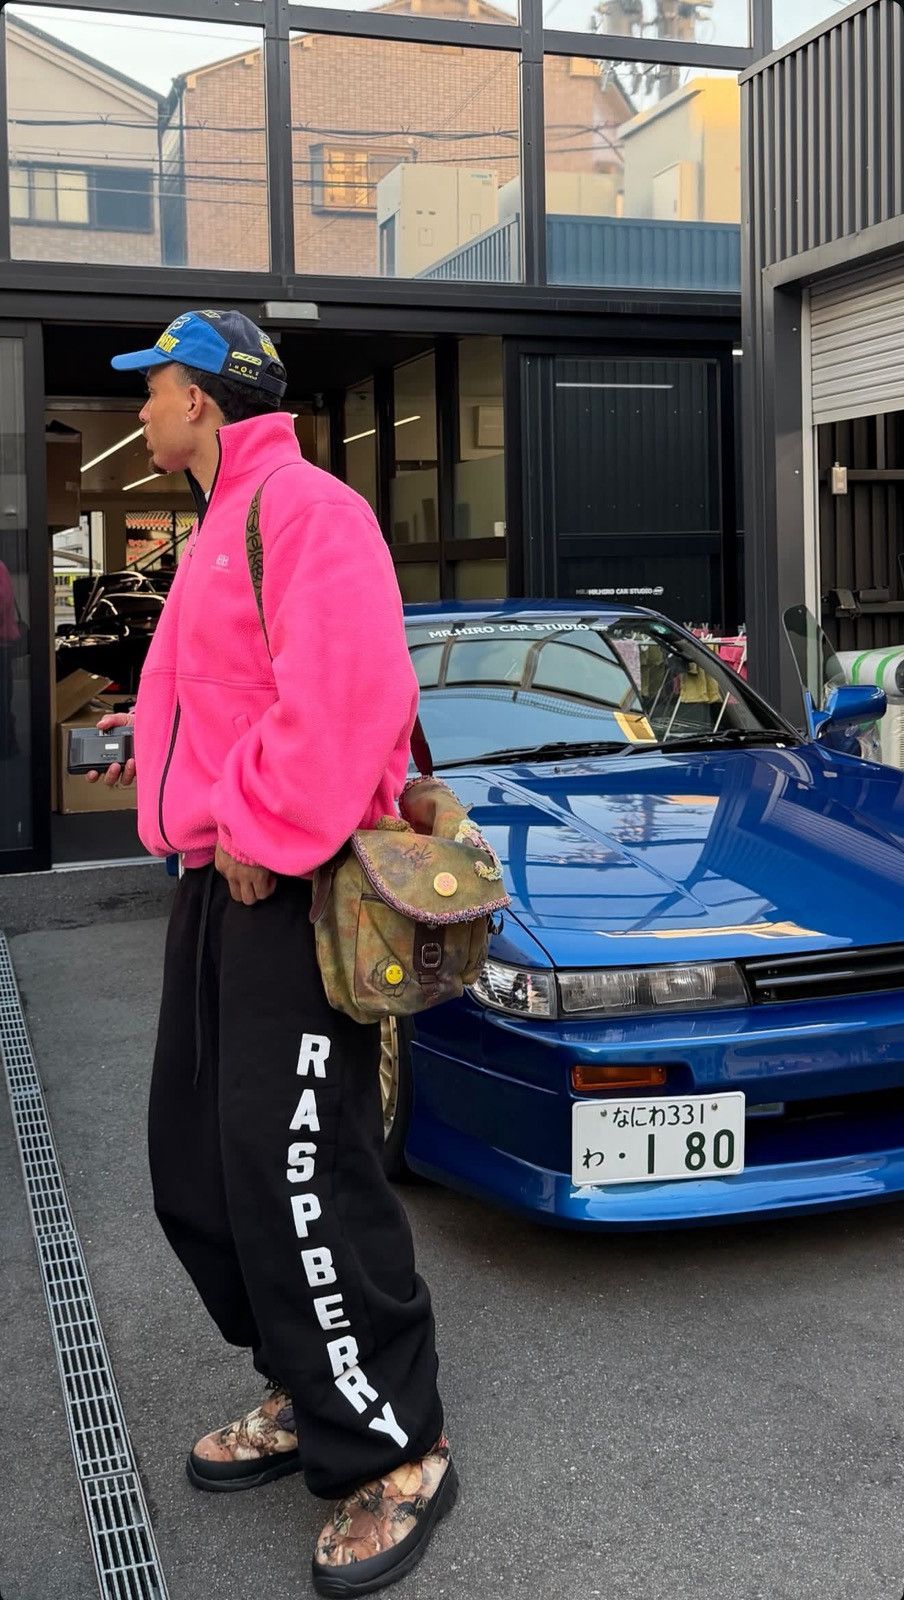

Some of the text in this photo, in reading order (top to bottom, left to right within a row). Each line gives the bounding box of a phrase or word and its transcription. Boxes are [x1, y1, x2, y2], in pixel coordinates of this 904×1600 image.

[428, 626, 495, 639] MR.HIRO
[499, 624, 531, 632] CAR
[532, 623, 590, 631] STUDIO
[286, 1033, 409, 1449] RASPBERRY
